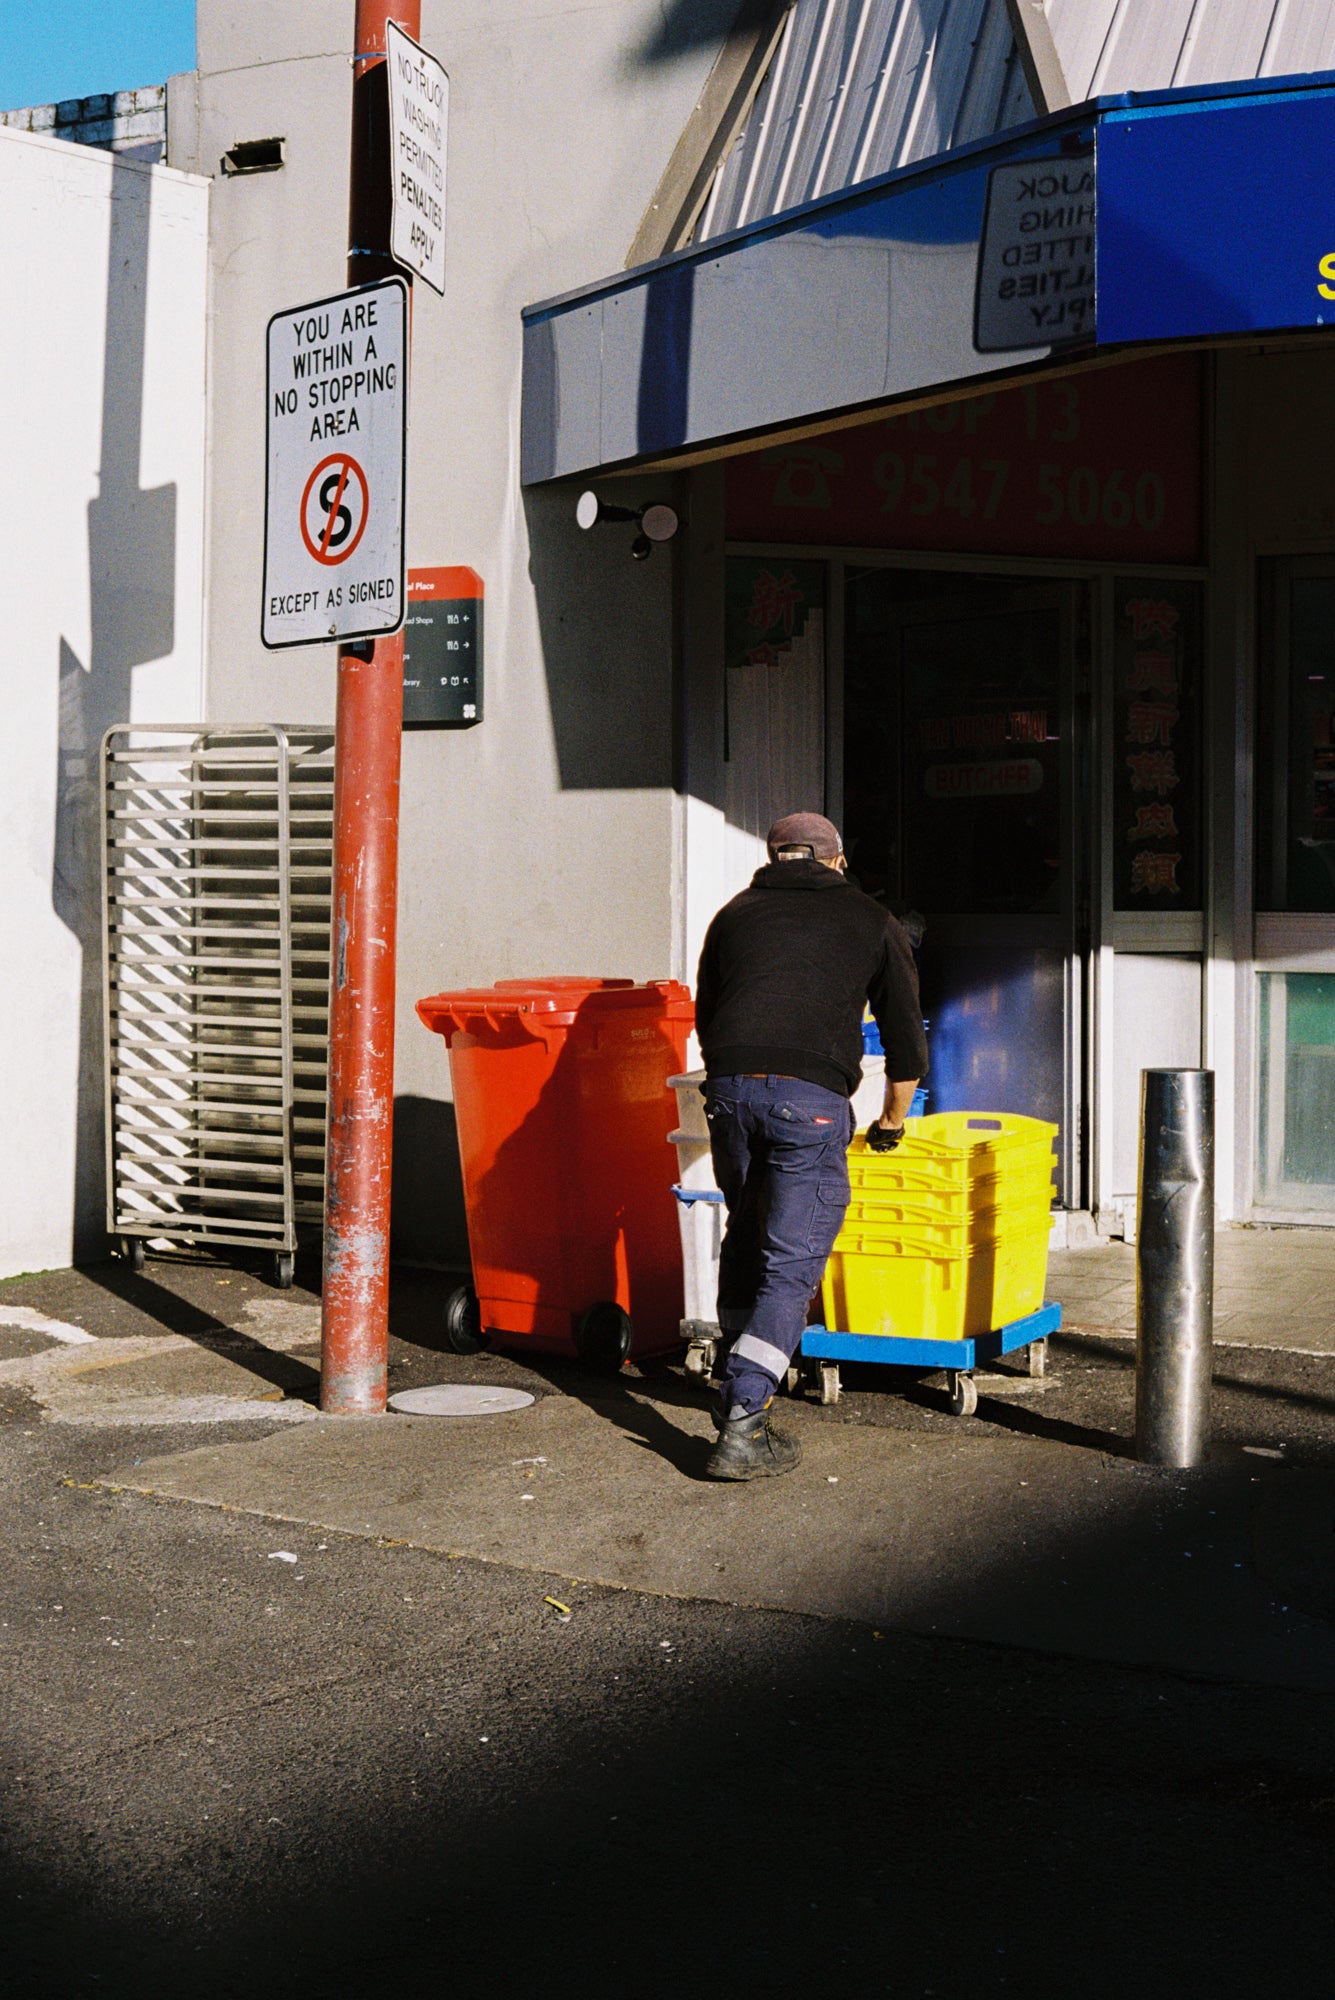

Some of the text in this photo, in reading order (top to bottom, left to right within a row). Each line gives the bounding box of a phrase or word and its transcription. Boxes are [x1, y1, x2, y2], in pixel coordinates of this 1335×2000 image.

[398, 52, 445, 109] NO TRUCK
[403, 94, 441, 150] WASHING
[400, 131, 442, 192] PERMITTED
[401, 172, 442, 231] PENALTIES
[410, 221, 435, 262] APPLY
[293, 300, 378, 346] YOU ARE
[293, 335, 377, 380] WITHIN A
[275, 363, 396, 417] NO STOPPING
[1020, 381, 1081, 442] 13
[310, 407, 360, 442] AREA
[318, 474, 352, 547] S
[872, 450, 1166, 532] 9547 5060
[270, 578, 395, 616] EXCEPT AS SIGNED
[416, 581, 435, 591] Place
[416, 616, 434, 627] Shops
[935, 764, 1032, 793] BUTCHER
